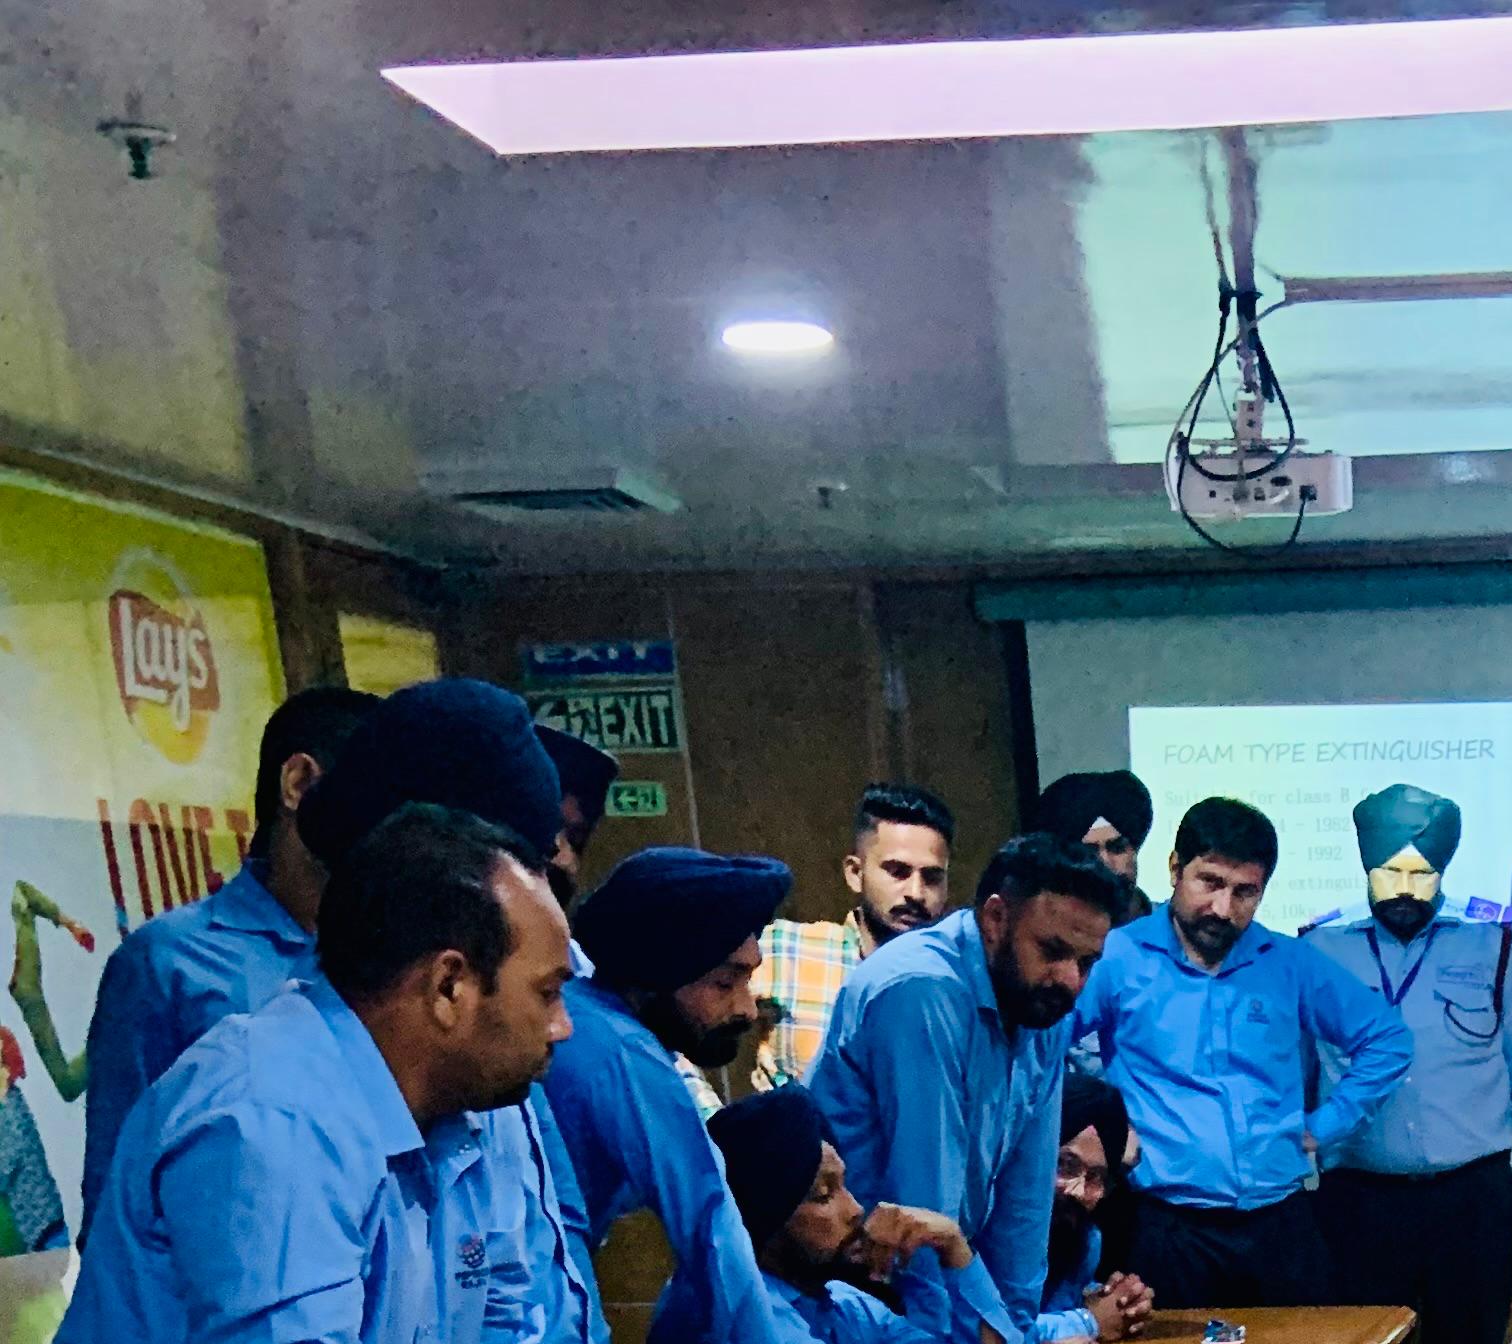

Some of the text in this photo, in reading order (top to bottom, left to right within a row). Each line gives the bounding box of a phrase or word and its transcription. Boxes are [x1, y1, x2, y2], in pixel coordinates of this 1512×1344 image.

[600, 694, 669, 746] EXIT
[1163, 737, 1496, 766] FOAM TYPE EXTINGUISHER
[1285, 787, 1331, 804] class
[1340, 787, 1351, 803] B
[1315, 816, 1353, 832] 1982
[1306, 845, 1343, 861] 1992
